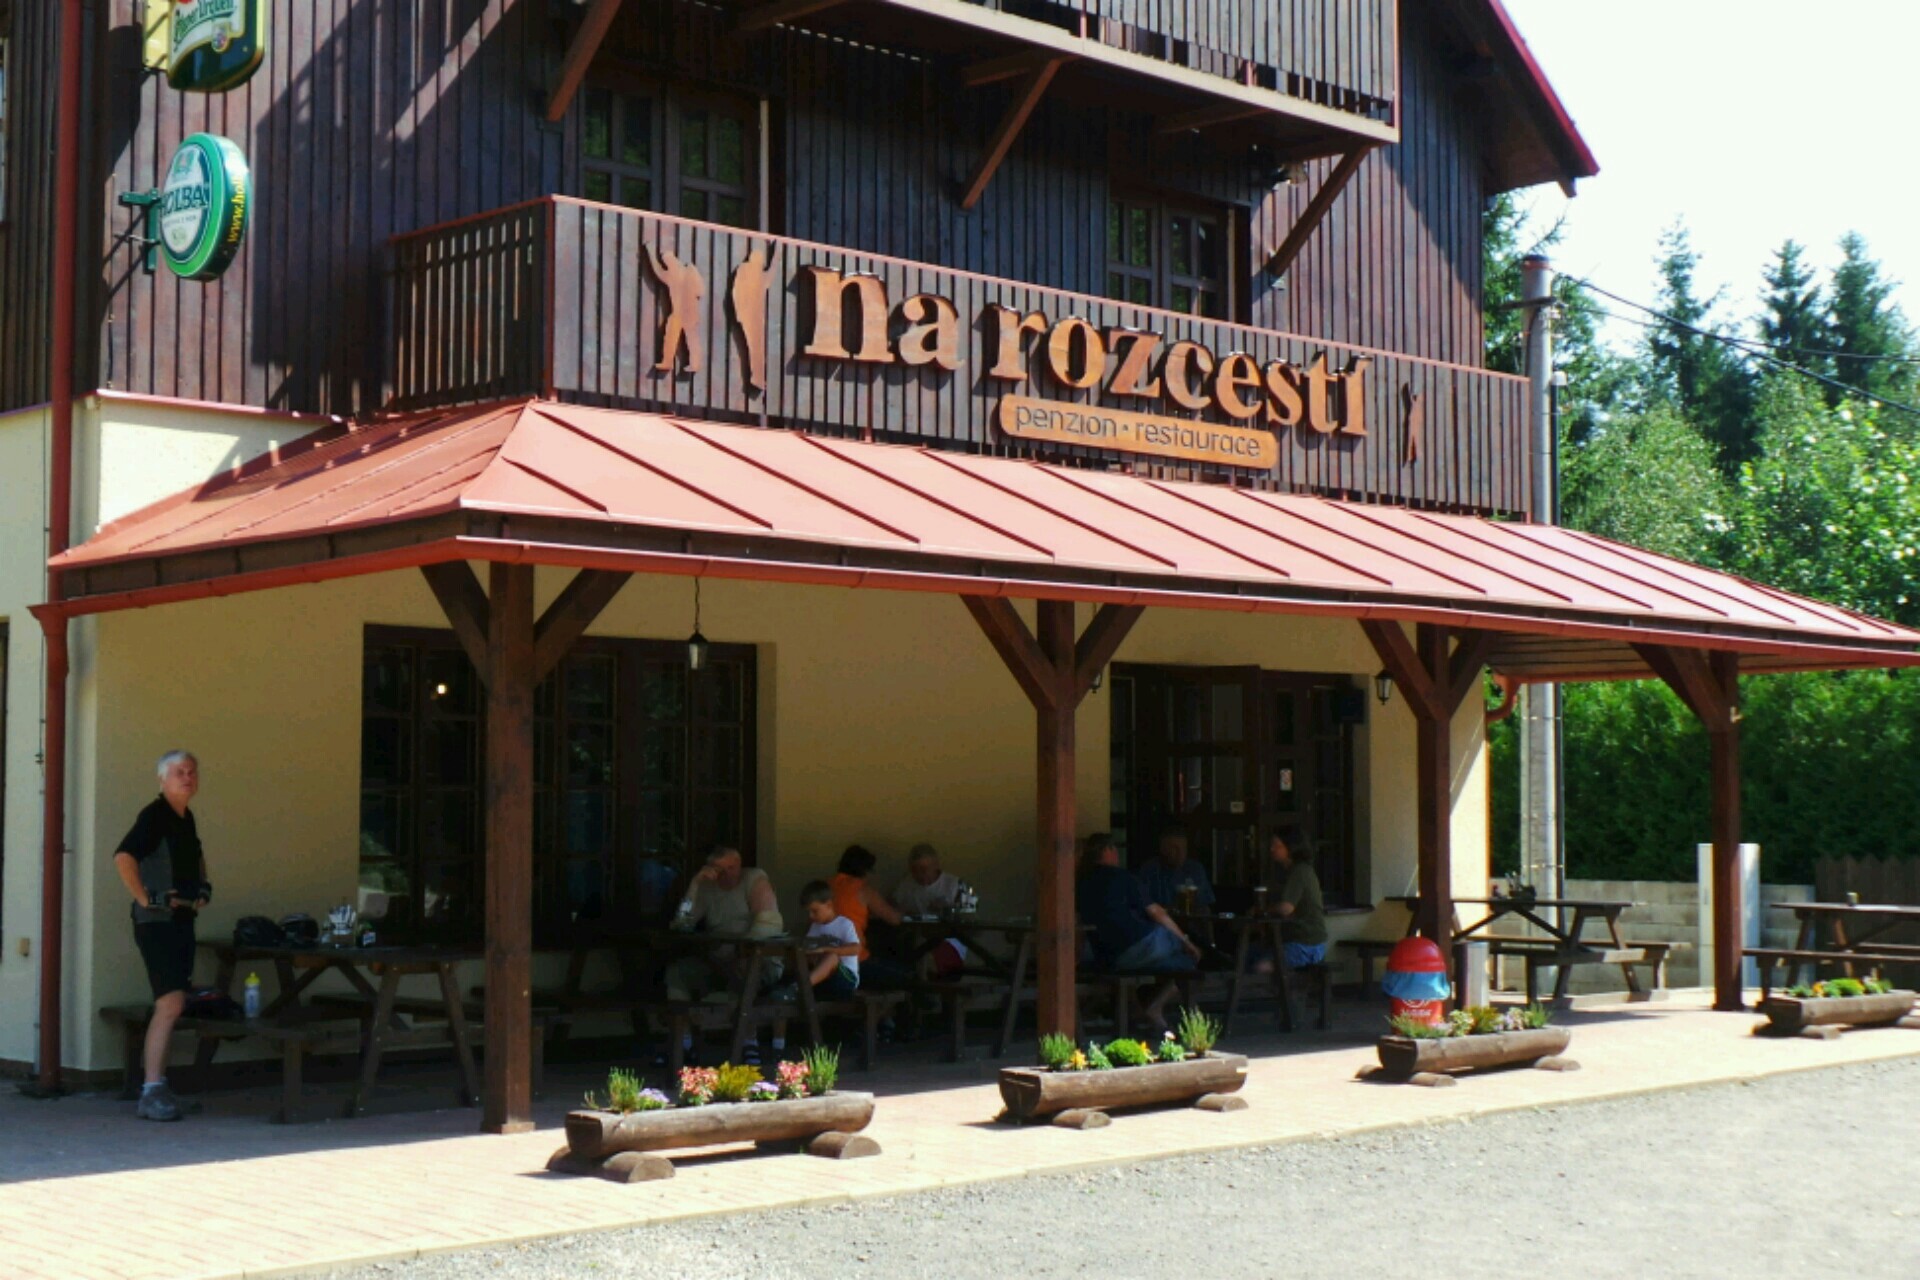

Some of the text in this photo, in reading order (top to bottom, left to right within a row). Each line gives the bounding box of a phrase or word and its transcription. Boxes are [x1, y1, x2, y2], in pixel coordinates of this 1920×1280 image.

[802, 264, 1372, 436] na rozcestí
[1016, 404, 1261, 457] penzion restaurace
